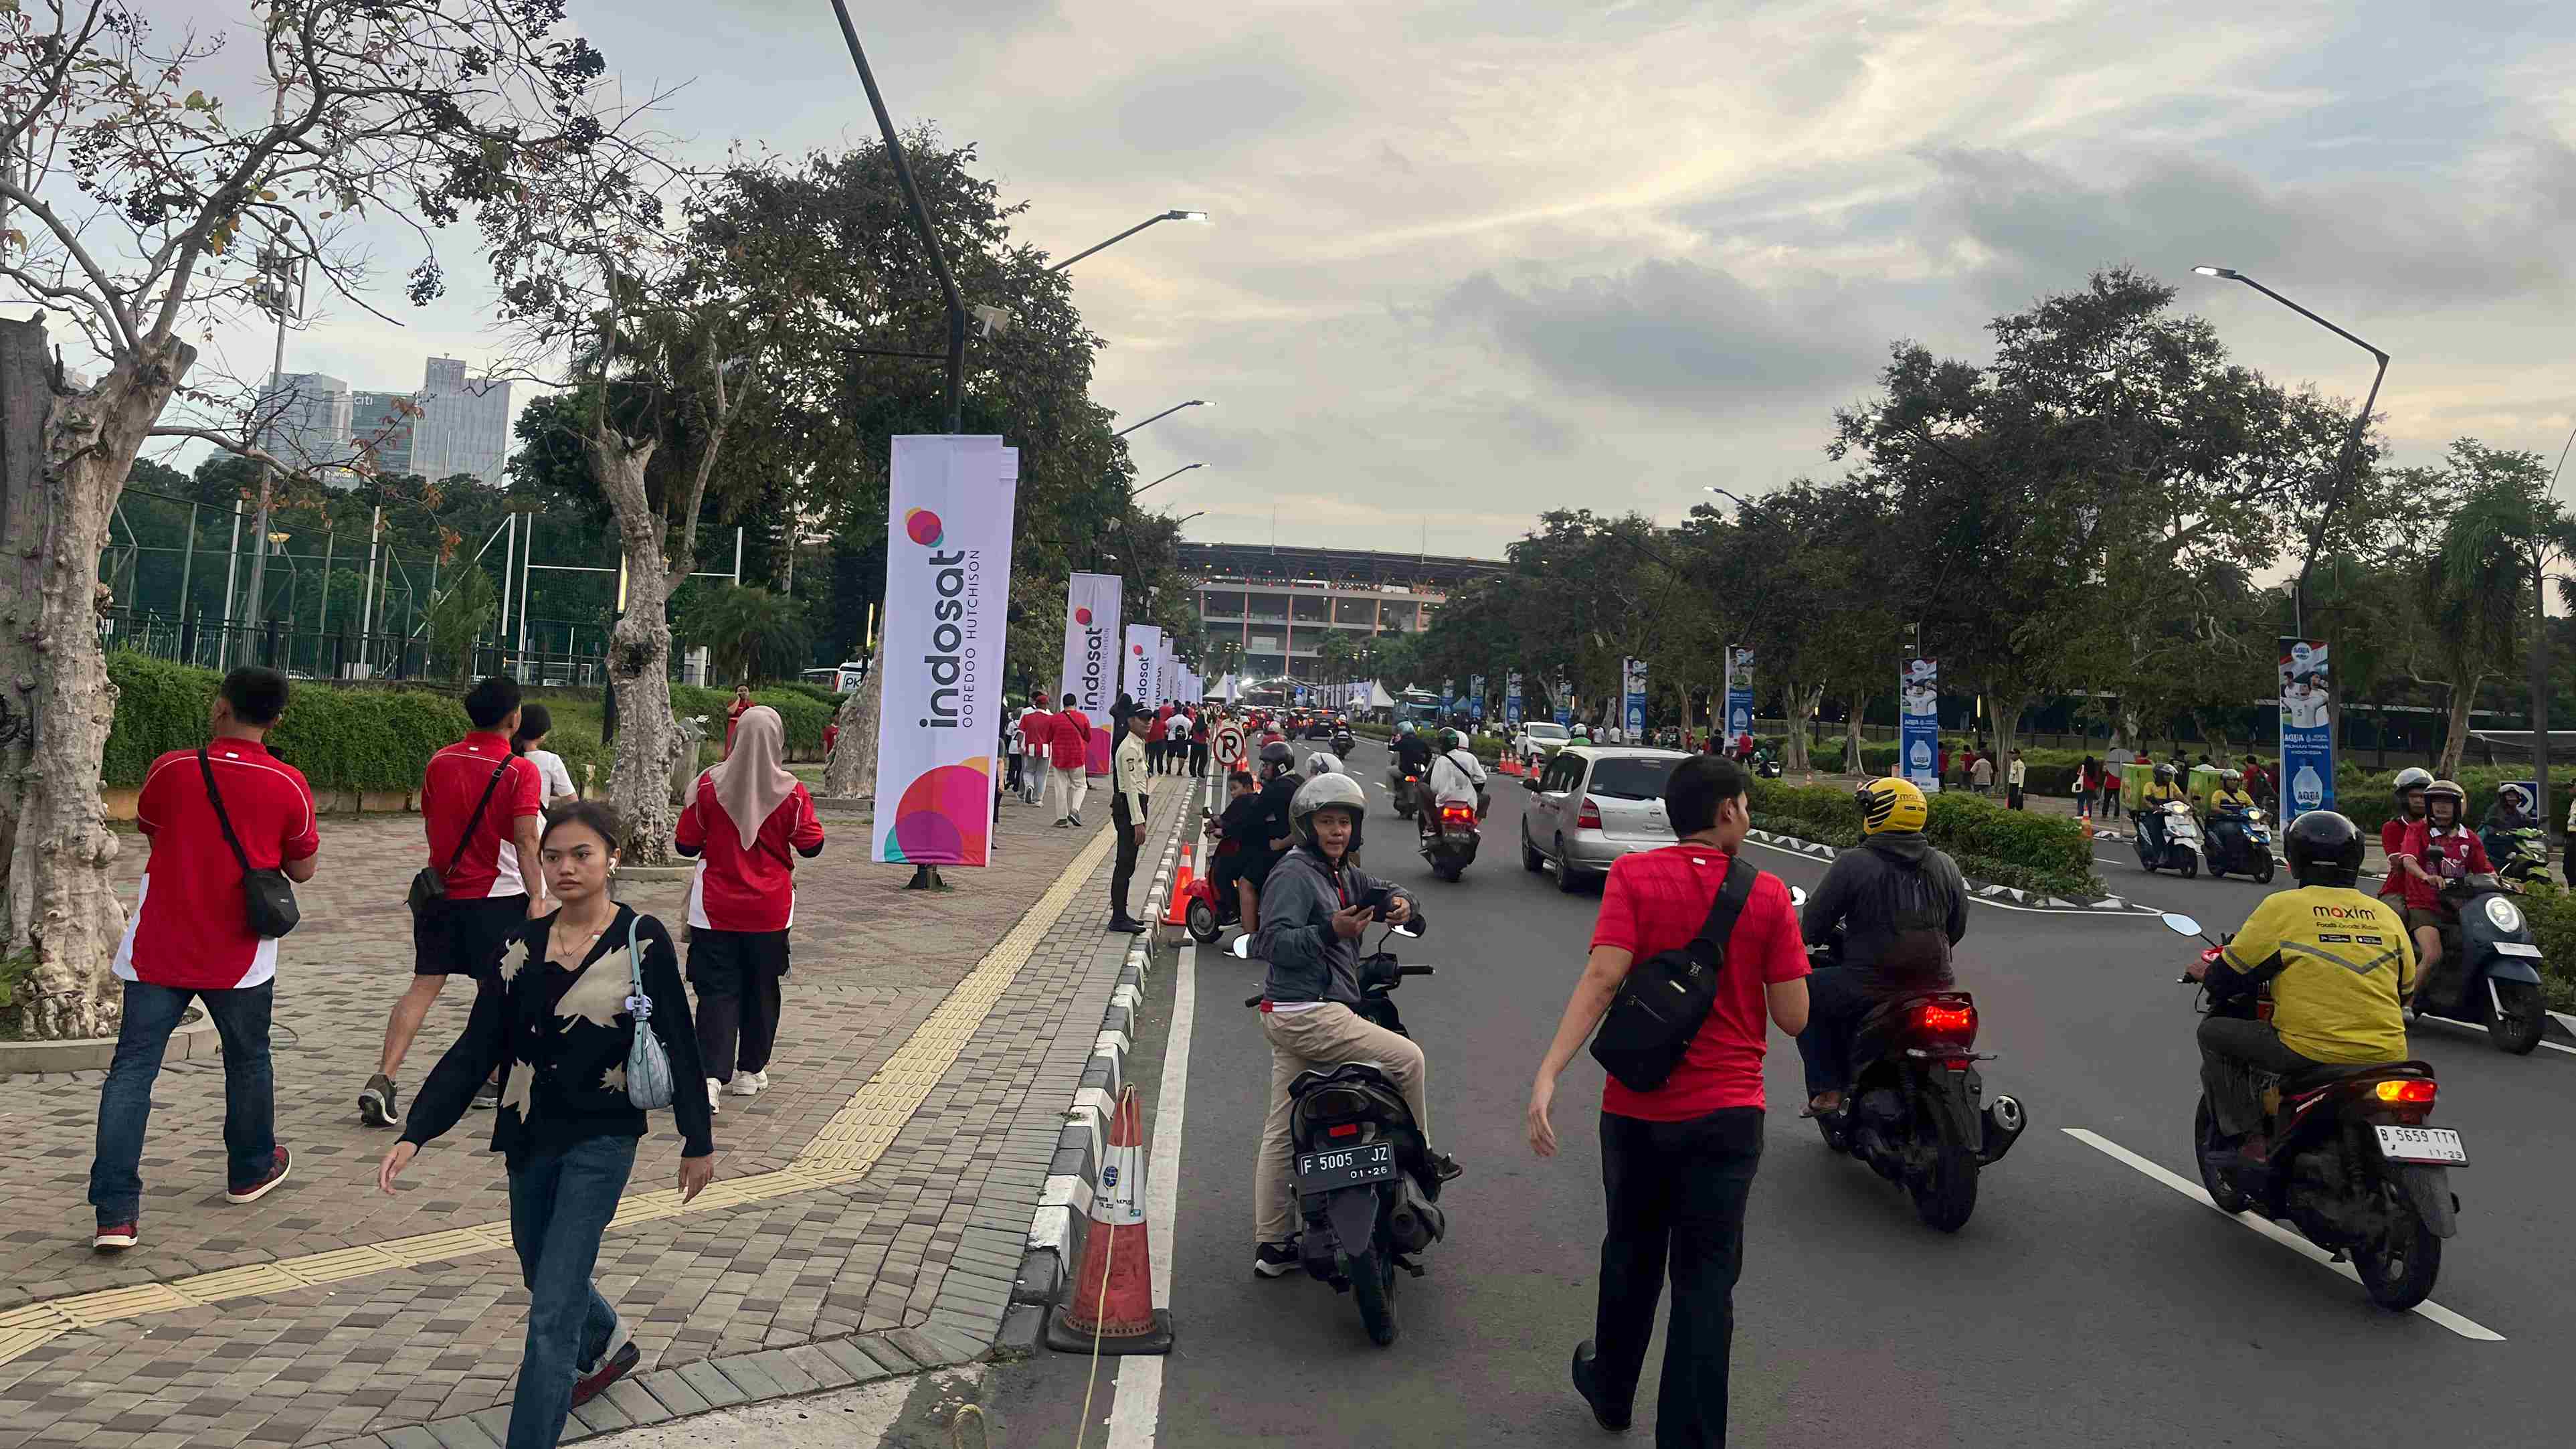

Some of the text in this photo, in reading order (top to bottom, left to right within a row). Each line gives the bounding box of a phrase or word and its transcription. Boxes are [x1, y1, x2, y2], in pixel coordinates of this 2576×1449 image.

[355, 396, 373, 406] citi
[919, 550, 965, 728] indosat
[962, 550, 980, 728] OOREDOO HUTCHISON
[1079, 627, 1103, 711] indosat
[1137, 657, 1149, 703] ndosat
[2284, 734, 2304, 742] AQUA
[2297, 790, 2320, 800] AQUA
[2313, 906, 2375, 920] maxim
[2380, 1128, 2457, 1144] B 5659 TTY
[1305, 1146, 1388, 1174] F 5005 JZ
